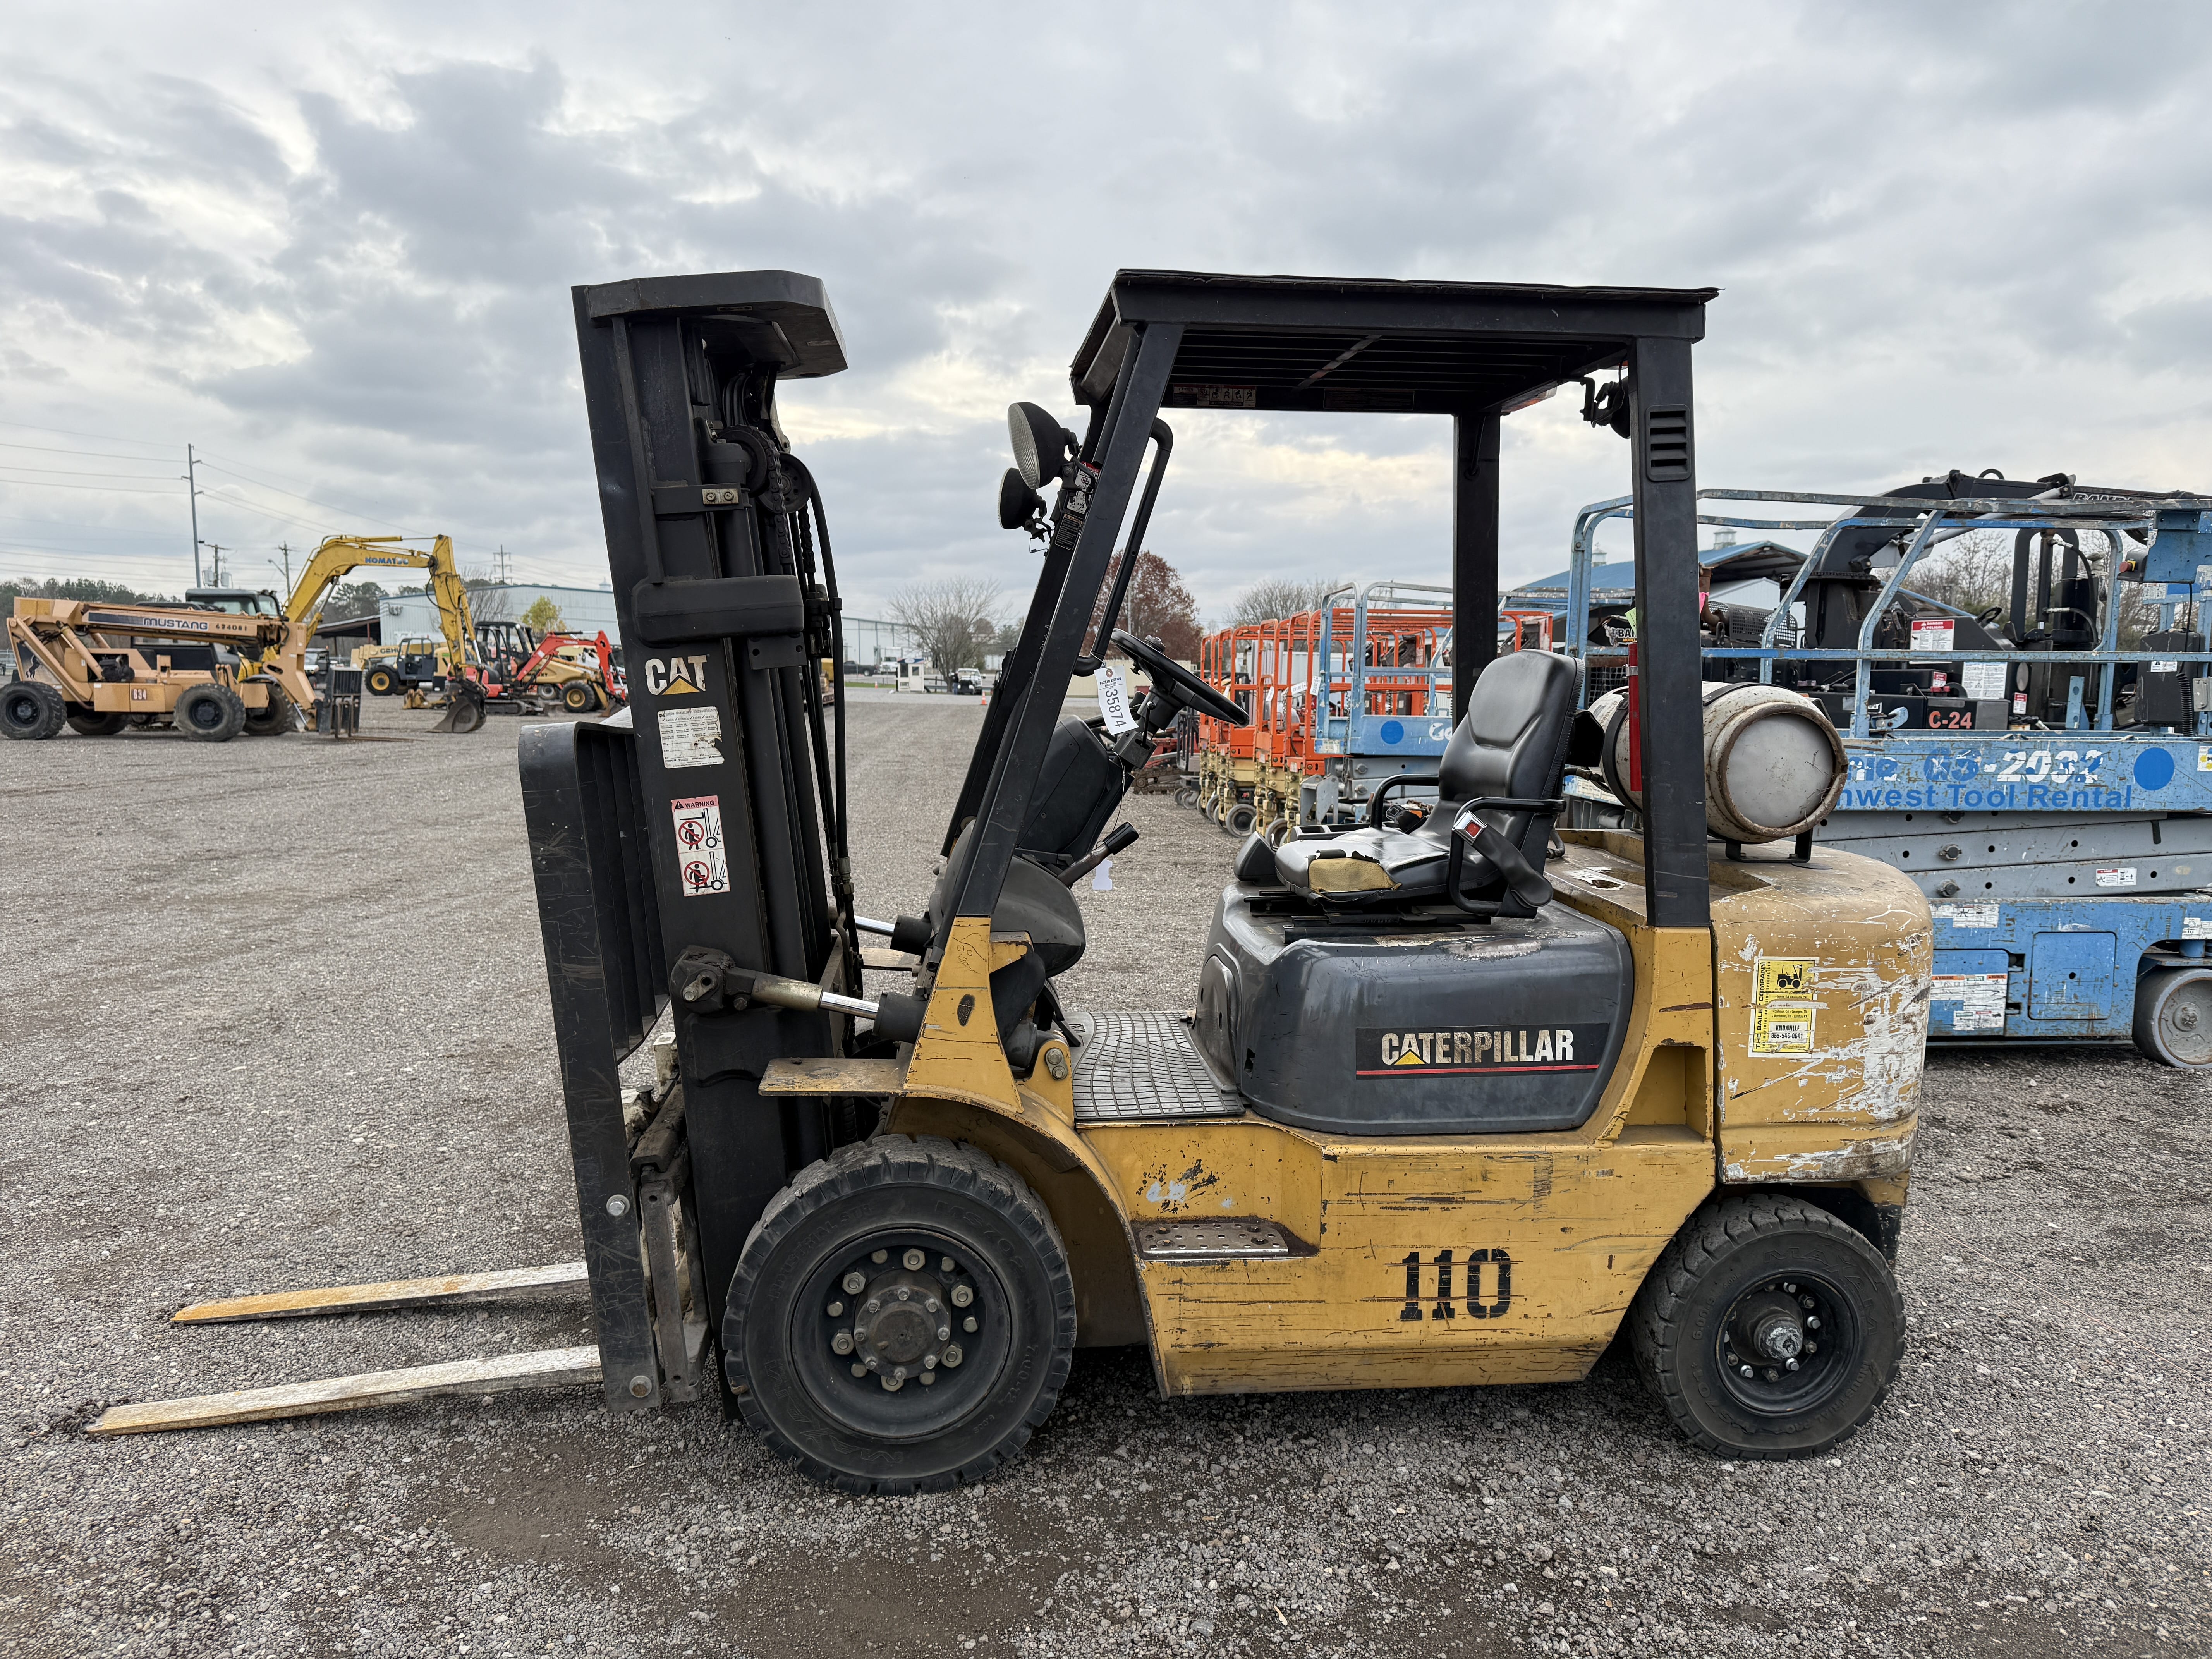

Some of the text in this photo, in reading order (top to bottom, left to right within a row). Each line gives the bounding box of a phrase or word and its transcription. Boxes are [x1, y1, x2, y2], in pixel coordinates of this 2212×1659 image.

[143, 618, 208, 630] MUSTANG
[645, 655, 707, 696] CAT
[1106, 689, 1127, 727] 35874
[1929, 711, 1973, 730] C-24
[684, 800, 714, 808] WARNING
[1947, 784, 2014, 807] Tool
[2027, 785, 2131, 808] Rental
[1382, 1029, 1573, 1065] CATERPILLAR
[1400, 1249, 1511, 1321] 110
